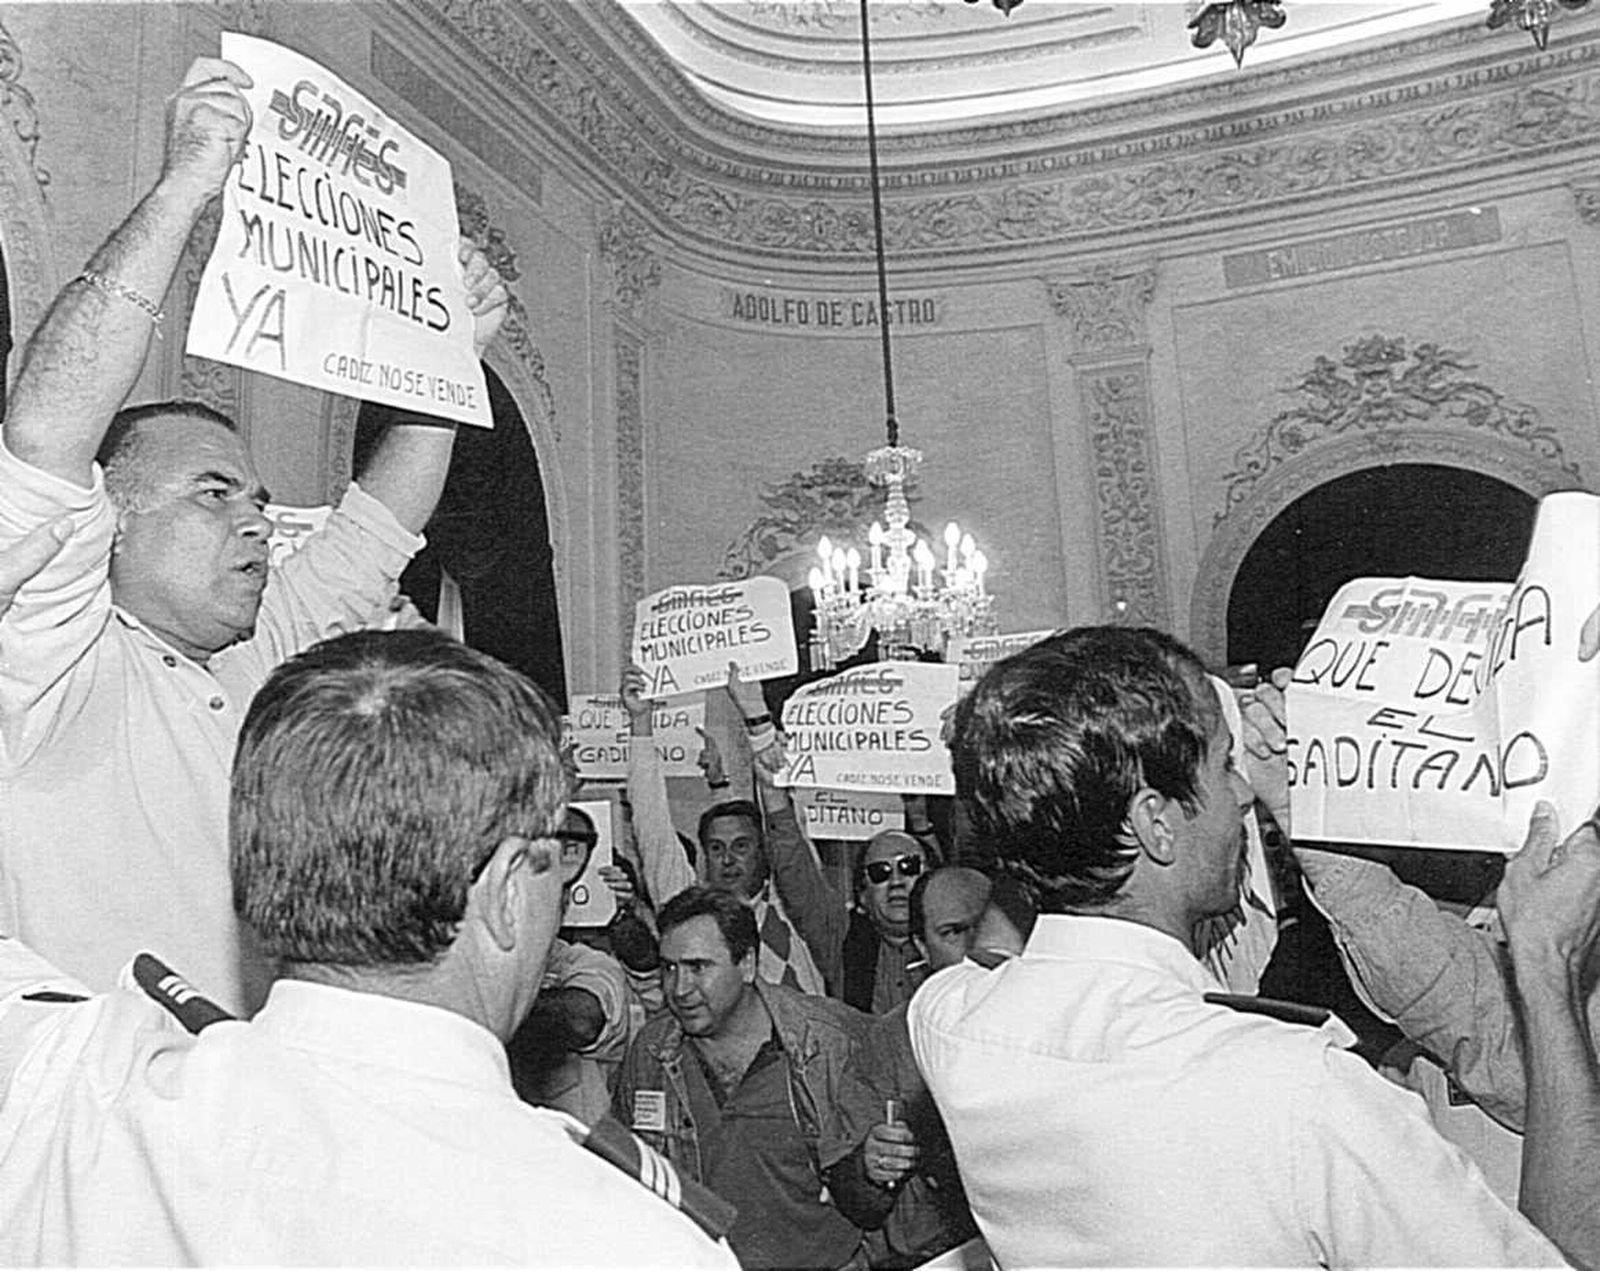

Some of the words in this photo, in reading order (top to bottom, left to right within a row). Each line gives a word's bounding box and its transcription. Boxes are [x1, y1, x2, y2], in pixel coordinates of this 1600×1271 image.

[221, 271, 287, 371] YA
[732, 292, 809, 325] ADOLFO
[816, 301, 844, 326] DE
[851, 298, 936, 327] CASTRO
[323, 352, 373, 385] CADIZ
[640, 622, 771, 663] MUNICIPALES
[641, 665, 680, 694] YA
[1291, 638, 1391, 691] QUE
[1366, 706, 1475, 743] EL
[579, 746, 685, 763] GADINO
[785, 754, 817, 784] YA
